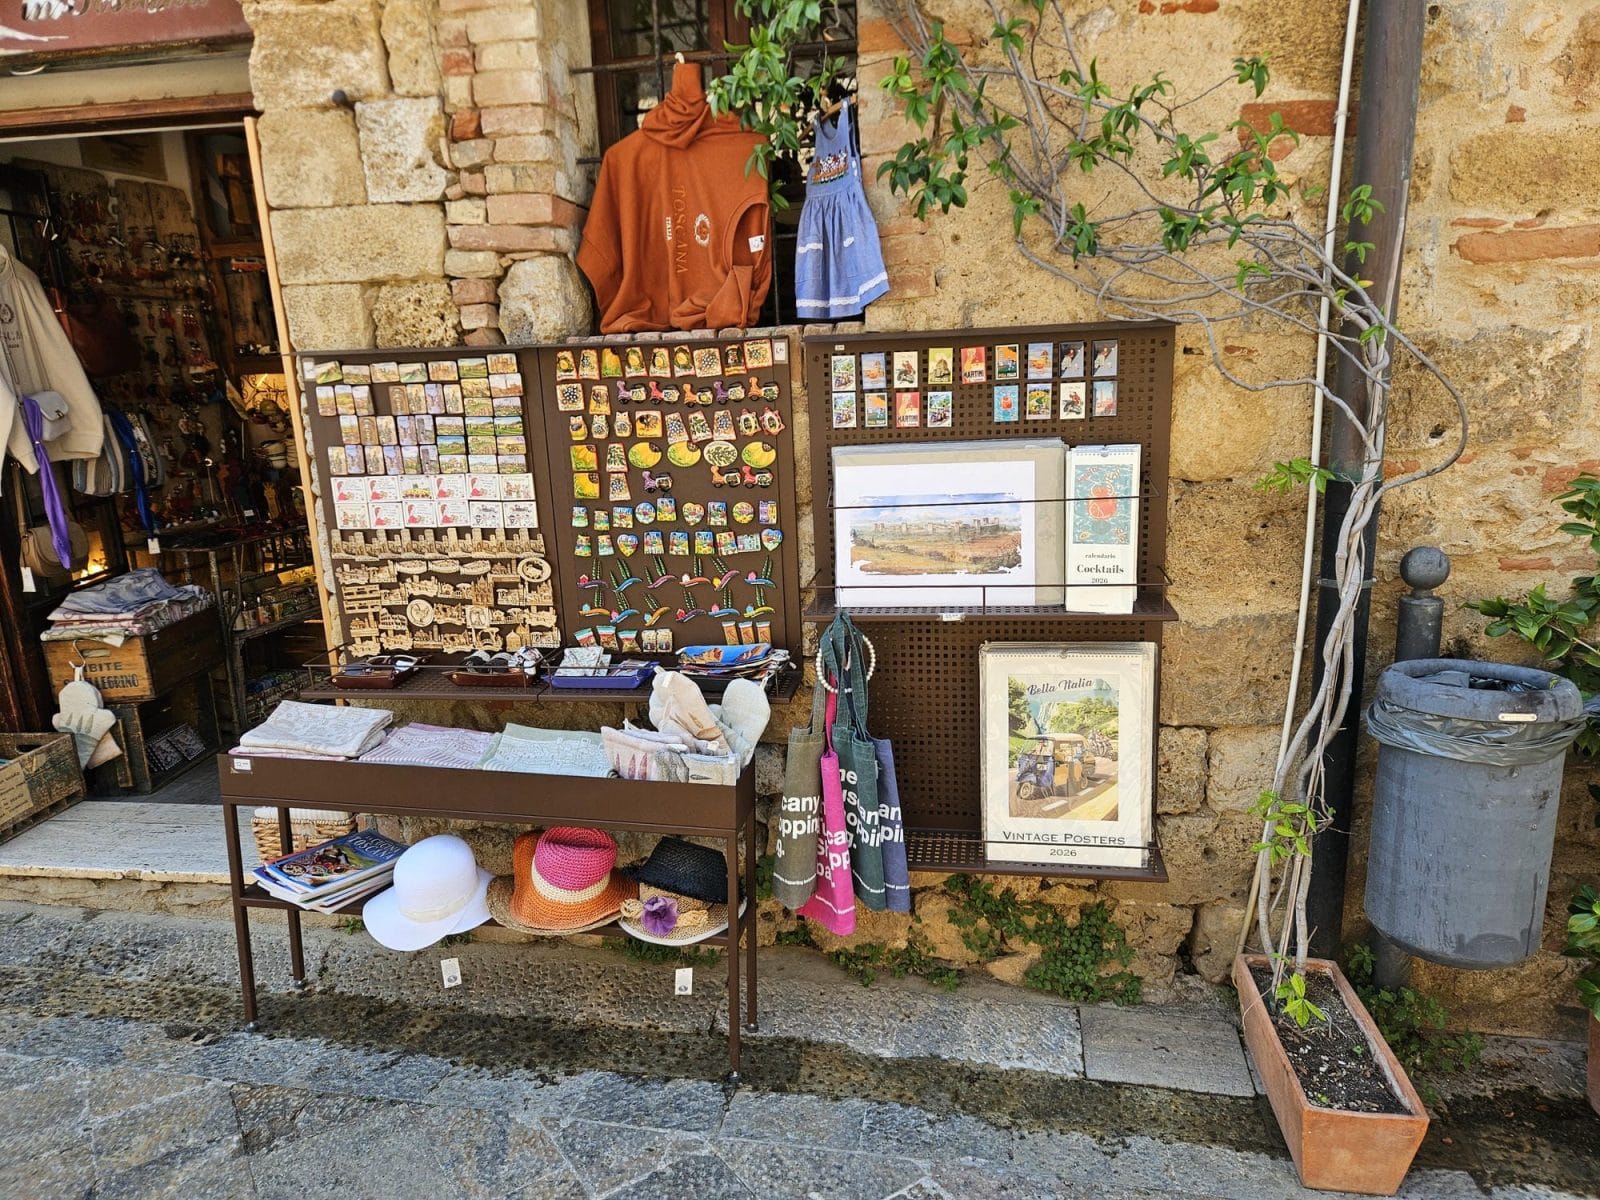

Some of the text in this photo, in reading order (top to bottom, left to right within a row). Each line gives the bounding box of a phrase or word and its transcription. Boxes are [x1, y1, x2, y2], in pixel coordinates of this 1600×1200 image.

[665, 216, 673, 241] ITALIA
[672, 185, 689, 273] TOSCANA
[1076, 564, 1124, 574] Cocktails
[84, 661, 123, 673] IBITE
[1027, 677, 1093, 696] Bella Italia
[1002, 831, 1126, 846] VINTAGE POSTERS
[1049, 848, 1077, 857] 2026
